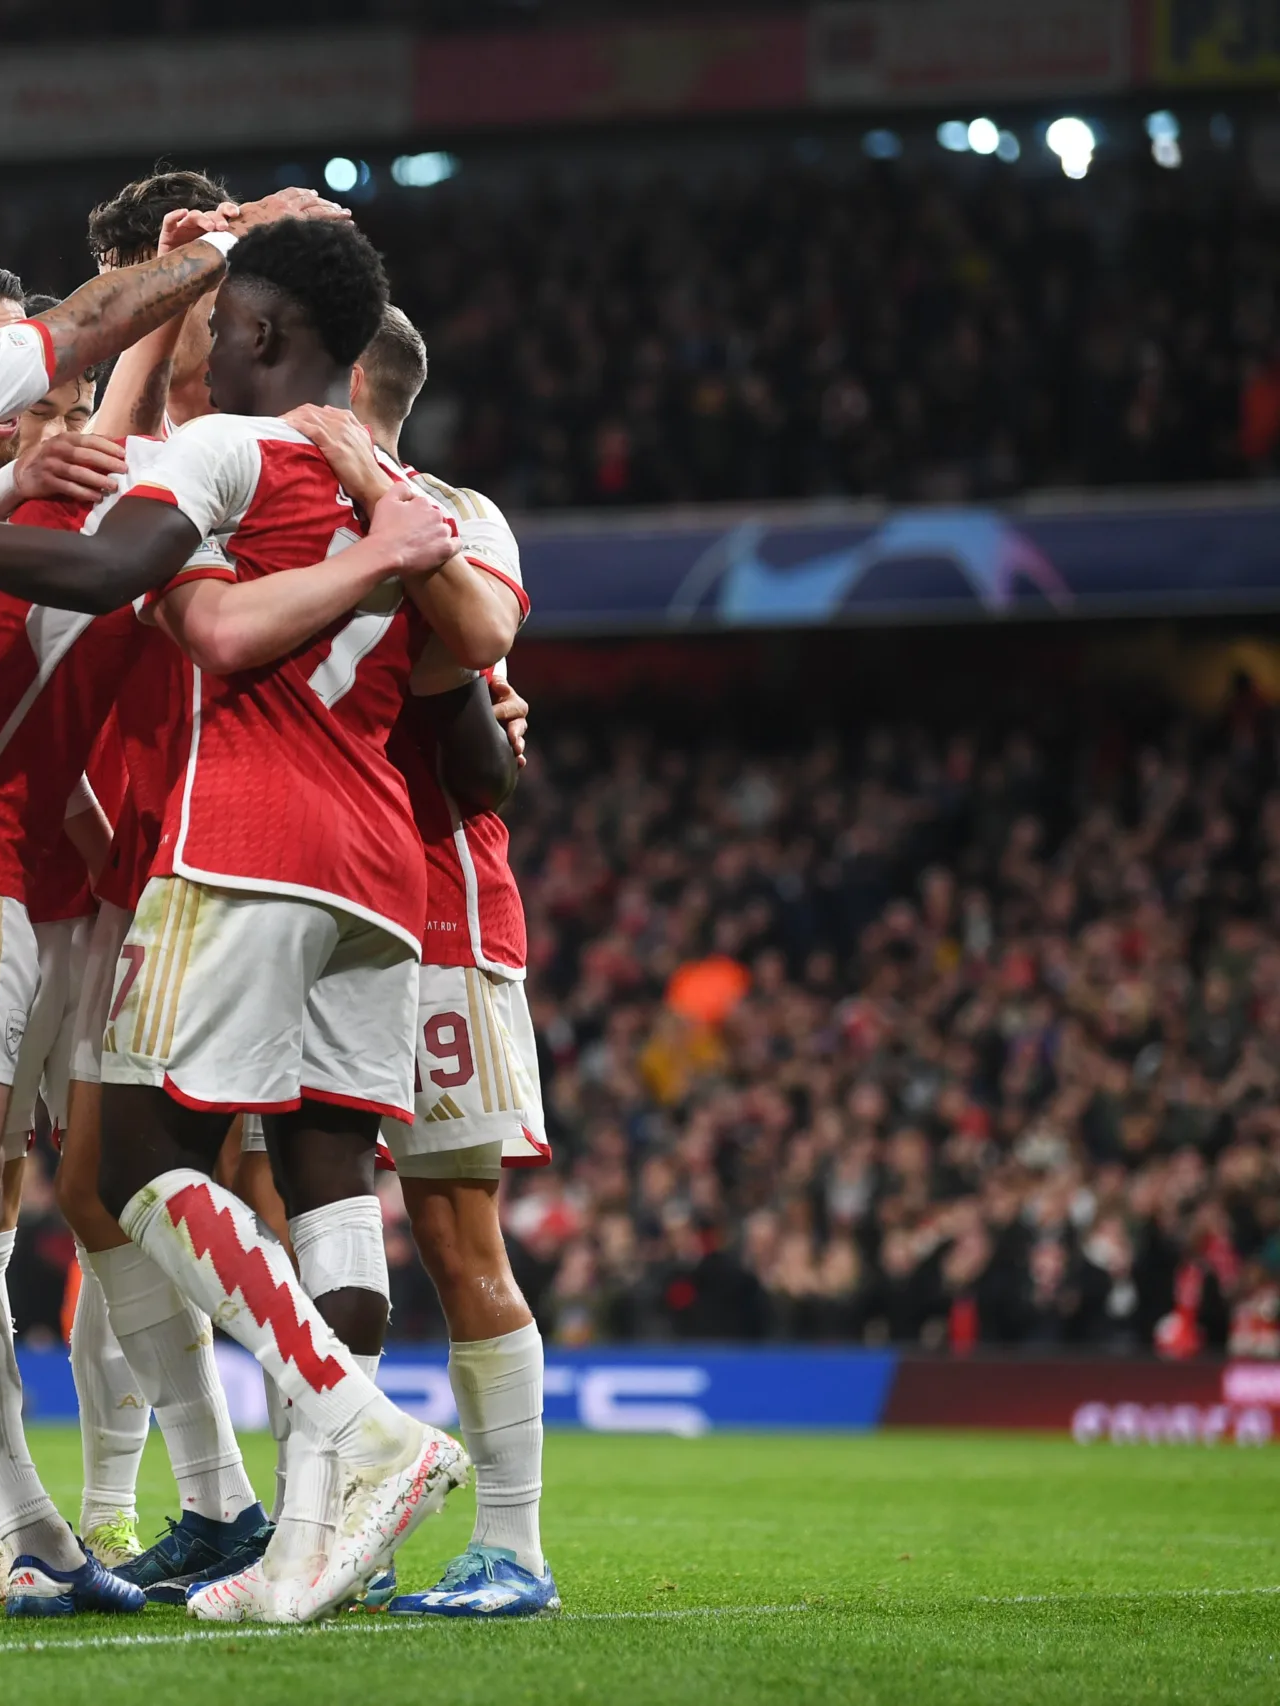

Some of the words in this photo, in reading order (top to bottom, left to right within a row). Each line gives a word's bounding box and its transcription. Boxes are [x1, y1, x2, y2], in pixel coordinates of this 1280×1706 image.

[110, 945, 145, 1022] 7
[415, 1011, 474, 1092] 9
[393, 1506, 413, 1537] new
[406, 1441, 439, 1505] balance
